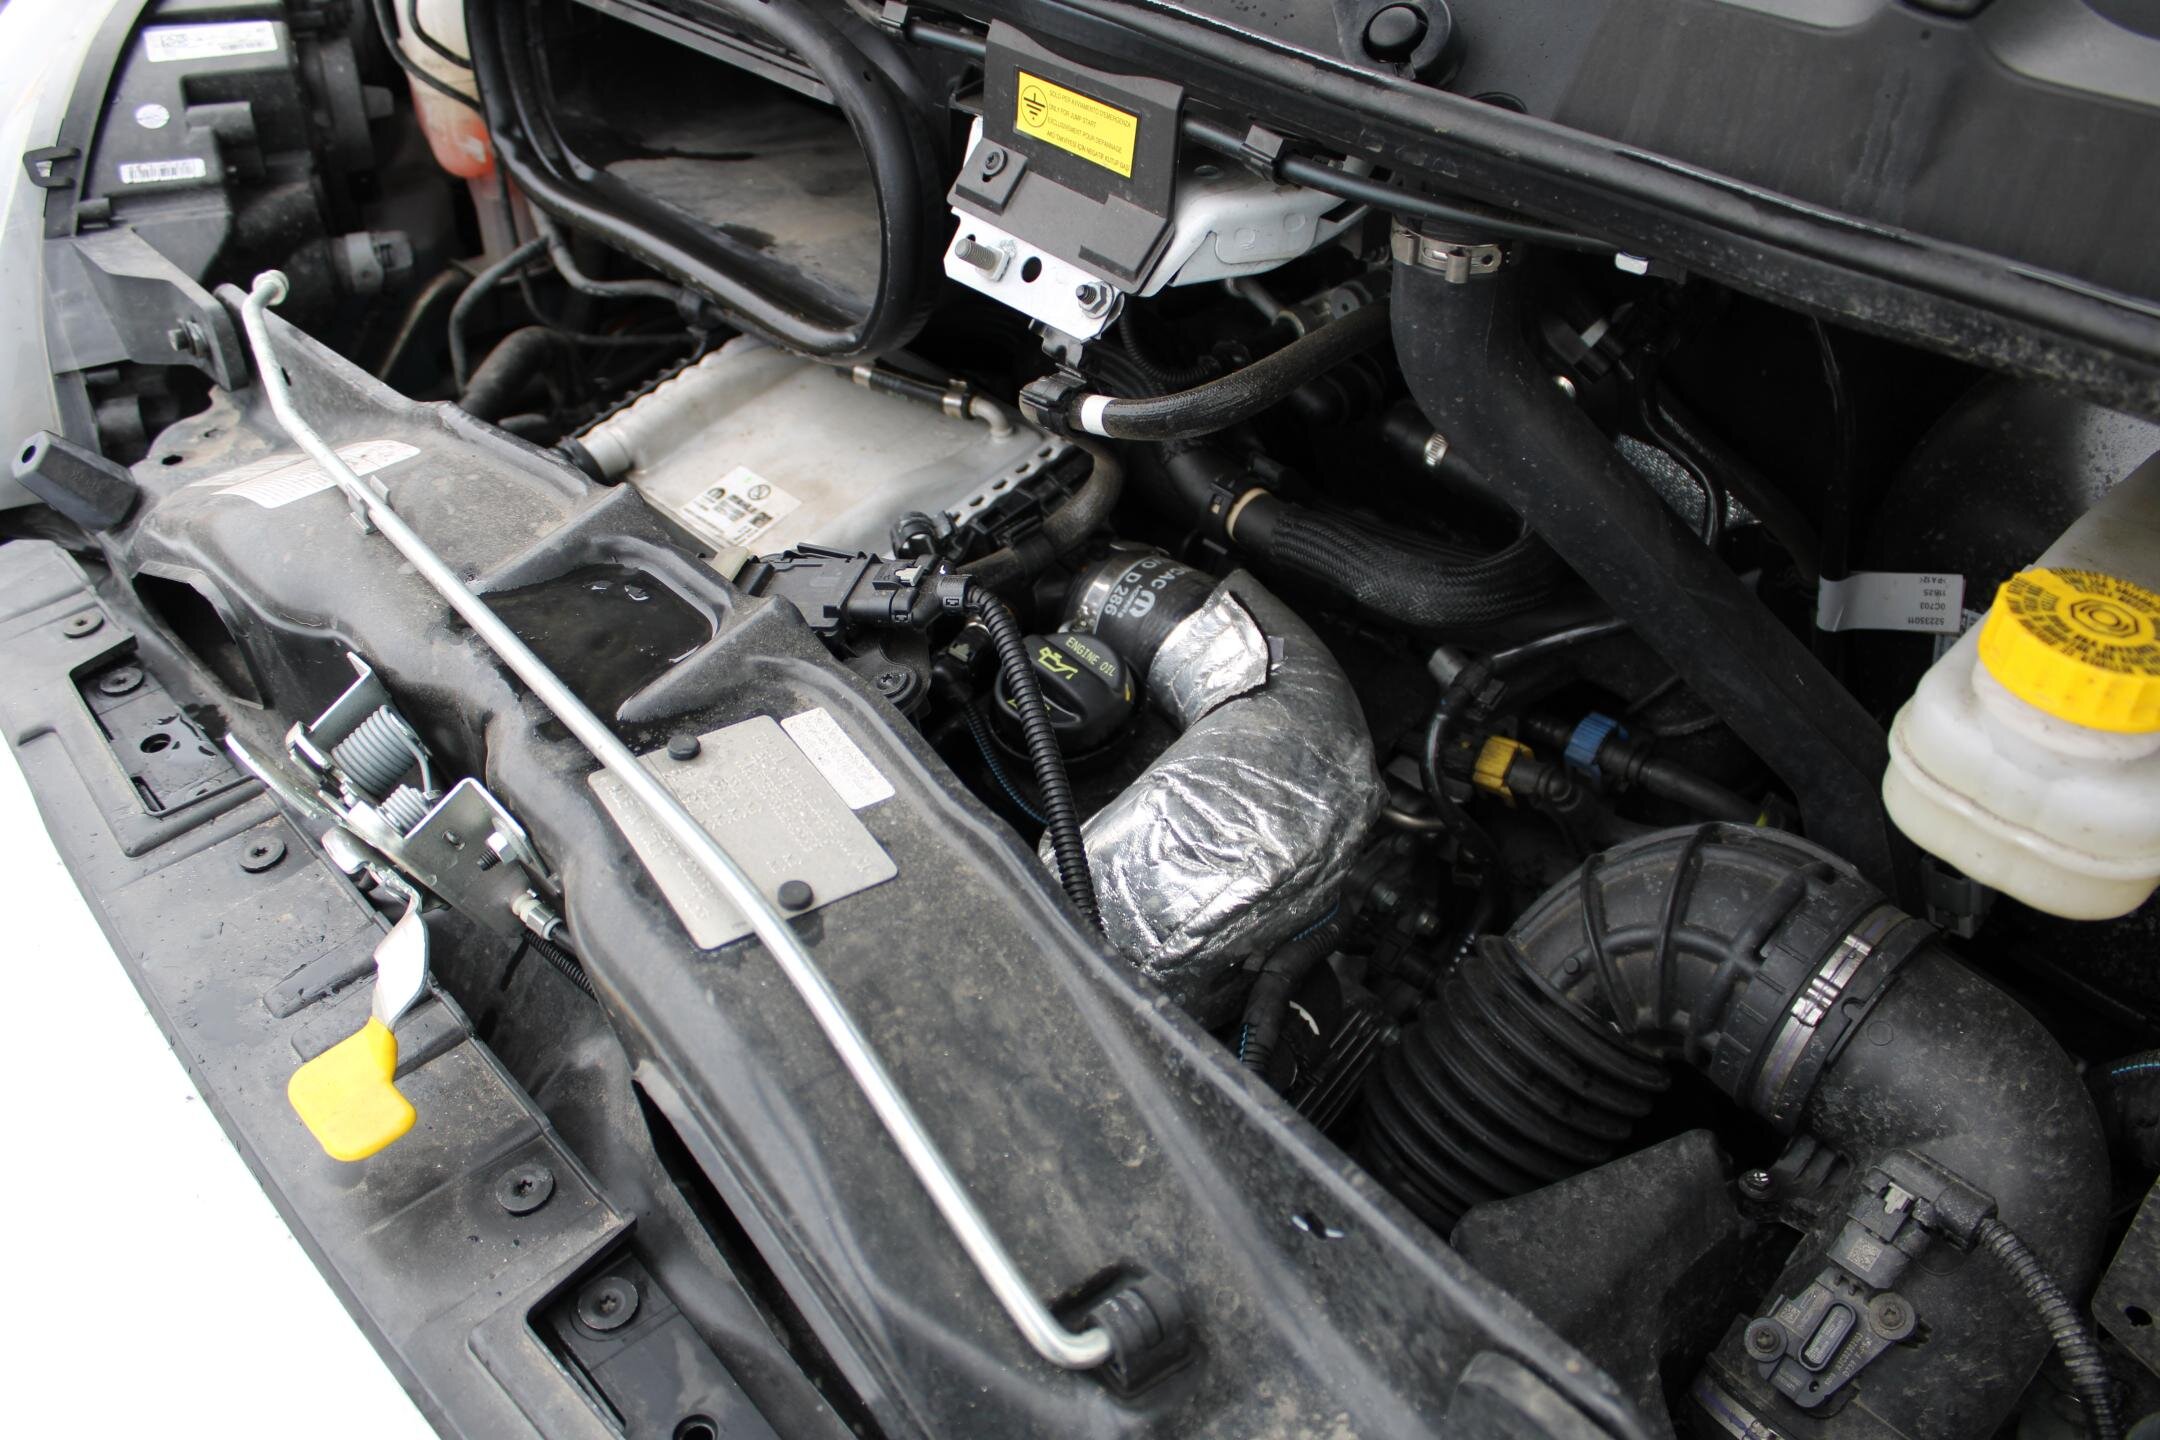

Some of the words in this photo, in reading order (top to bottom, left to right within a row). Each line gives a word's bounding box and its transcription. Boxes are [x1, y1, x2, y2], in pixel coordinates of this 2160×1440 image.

[1125, 572, 1143, 584] D
[1104, 584, 1130, 616] 286
[1065, 636, 1100, 666] ENGINE
[1099, 661, 1117, 677] OIL
